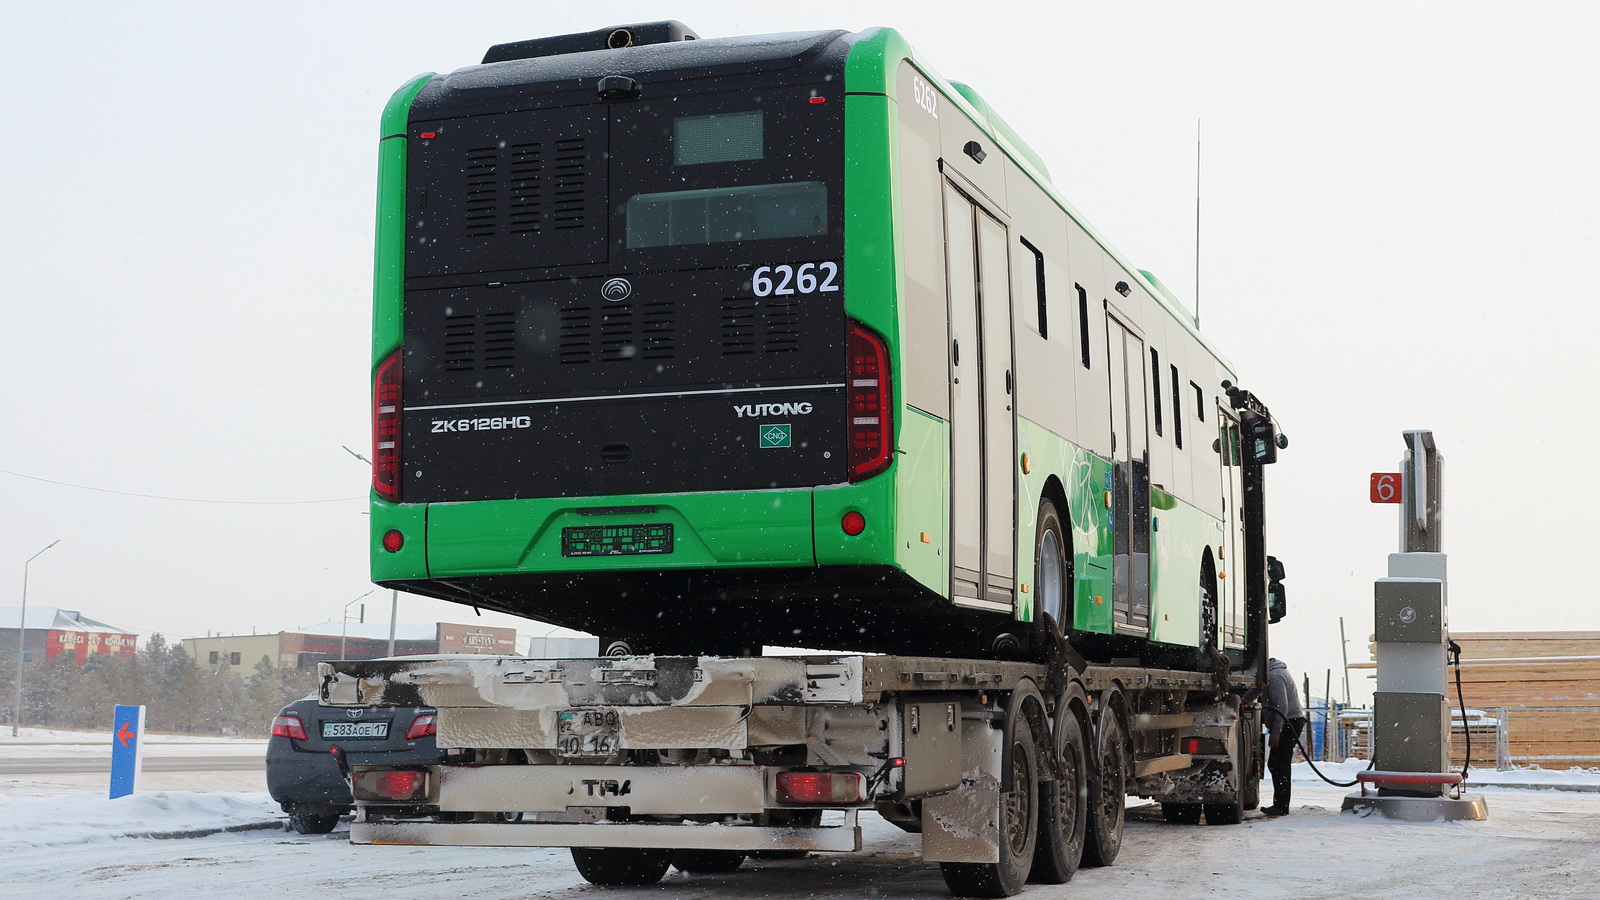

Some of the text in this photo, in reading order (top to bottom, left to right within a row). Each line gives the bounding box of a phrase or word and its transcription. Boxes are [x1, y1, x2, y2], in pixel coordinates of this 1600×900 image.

[913, 75, 938, 120] 6262
[752, 261, 839, 297] 6262
[733, 402, 813, 418] YUTONG
[431, 415, 531, 433] ZK6126HG
[767, 432, 784, 440] CNG
[1377, 475, 1395, 500] 6
[374, 723, 387, 736] 17
[560, 737, 580, 754] 10
